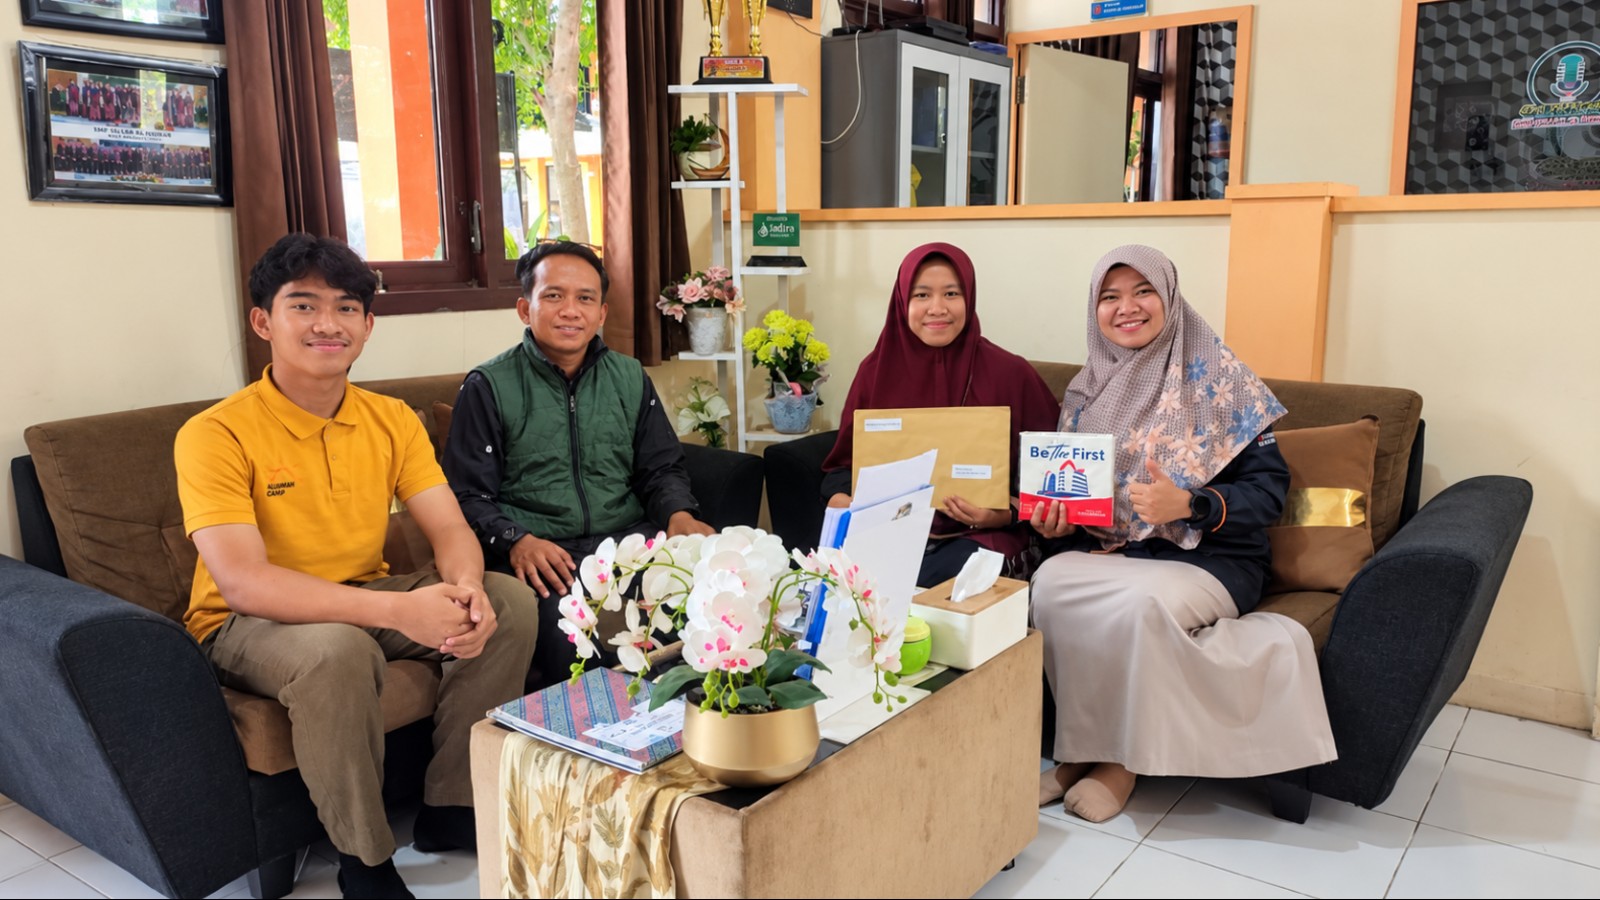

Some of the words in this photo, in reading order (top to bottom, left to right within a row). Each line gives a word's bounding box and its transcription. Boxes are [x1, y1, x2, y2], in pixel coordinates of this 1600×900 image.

[1030, 446, 1049, 458] Be
[1046, 443, 1070, 461] The
[1072, 448, 1105, 461] First
[267, 489, 286, 497] CAMP
